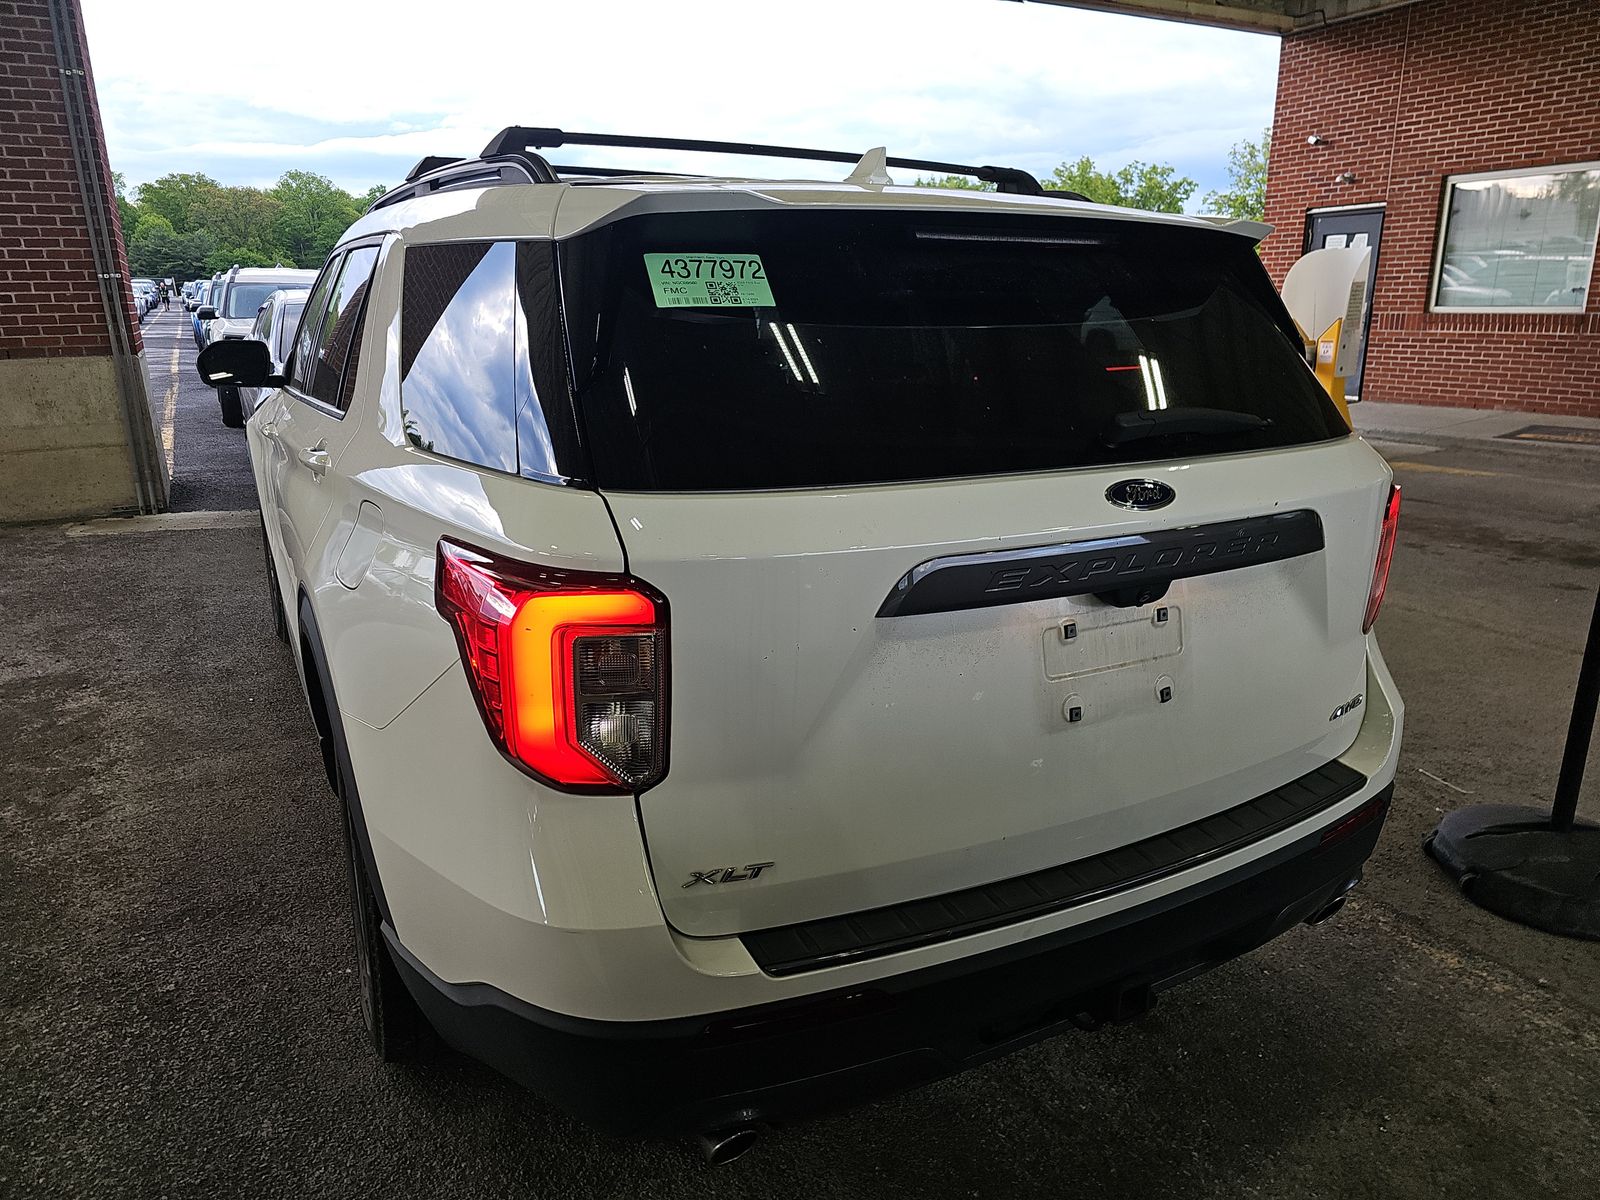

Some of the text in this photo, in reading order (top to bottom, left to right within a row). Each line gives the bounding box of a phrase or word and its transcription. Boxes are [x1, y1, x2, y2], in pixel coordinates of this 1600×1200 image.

[660, 258, 766, 280] 4377972
[663, 286, 688, 295] FMC
[985, 532, 1279, 592] EXPLORER
[681, 861, 775, 889] XLT
